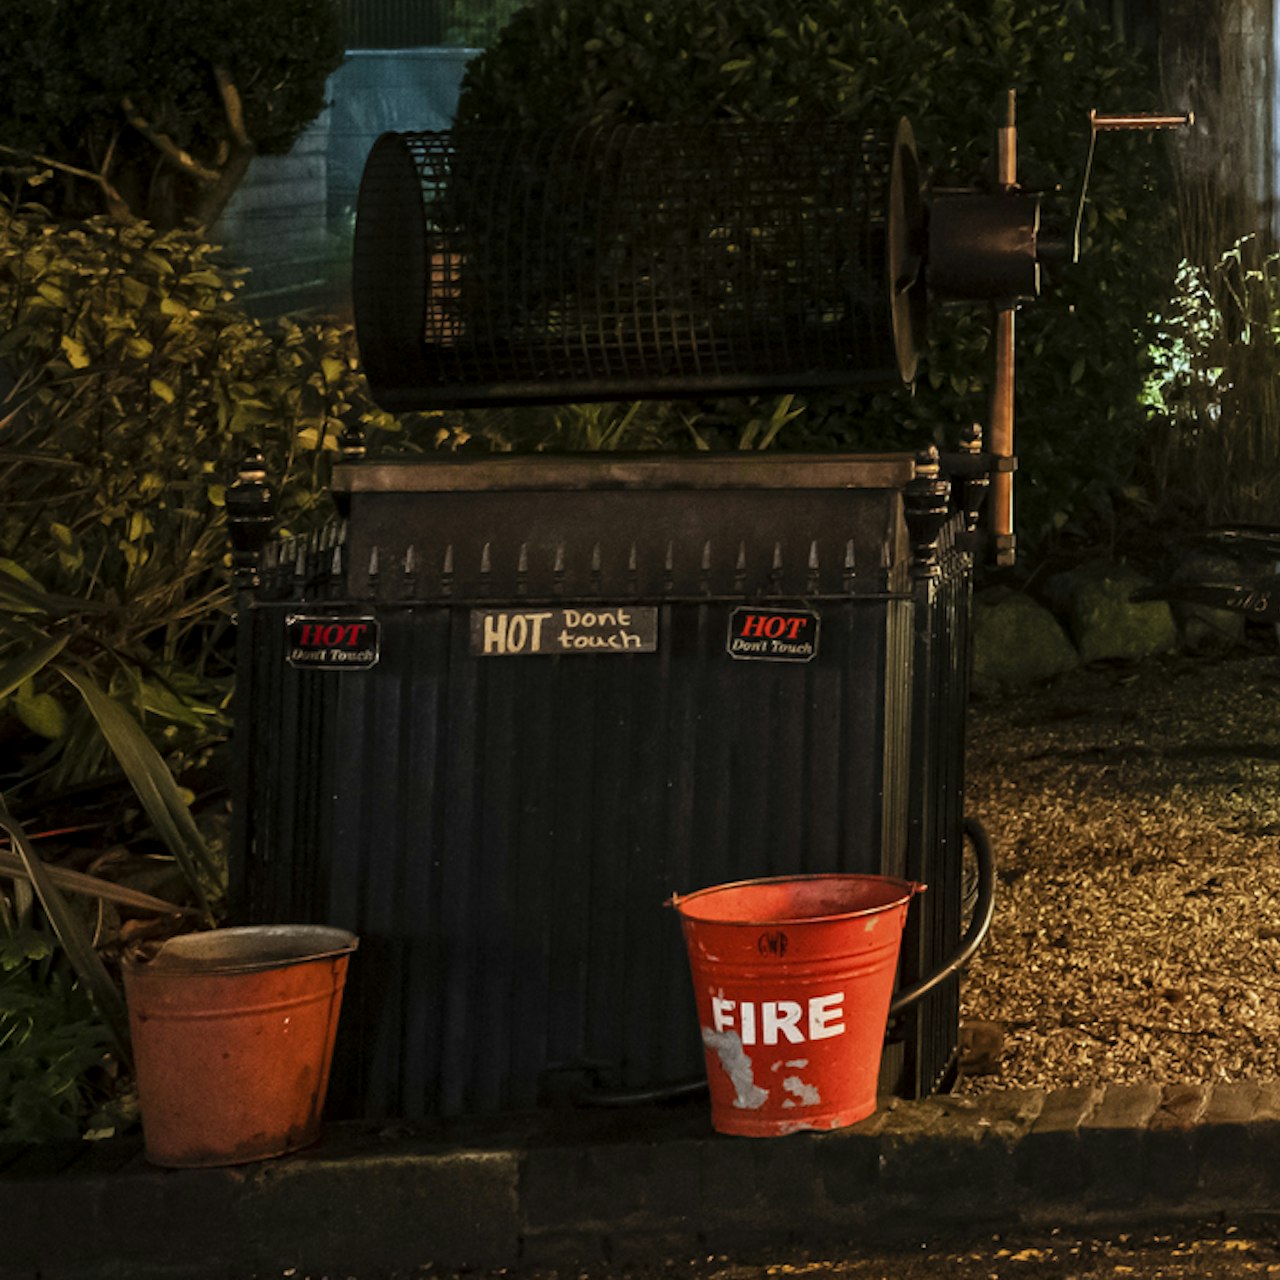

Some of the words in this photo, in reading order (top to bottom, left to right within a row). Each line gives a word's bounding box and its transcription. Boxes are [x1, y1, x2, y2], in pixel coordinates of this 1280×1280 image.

[562, 608, 631, 628] Dont
[741, 615, 808, 639] HOT
[300, 624, 367, 647] HOT
[483, 612, 553, 654] HOT
[557, 629, 642, 649] touch
[330, 649, 374, 662] Touch
[771, 640, 812, 654] Touch
[712, 992, 845, 1045] FIRE
